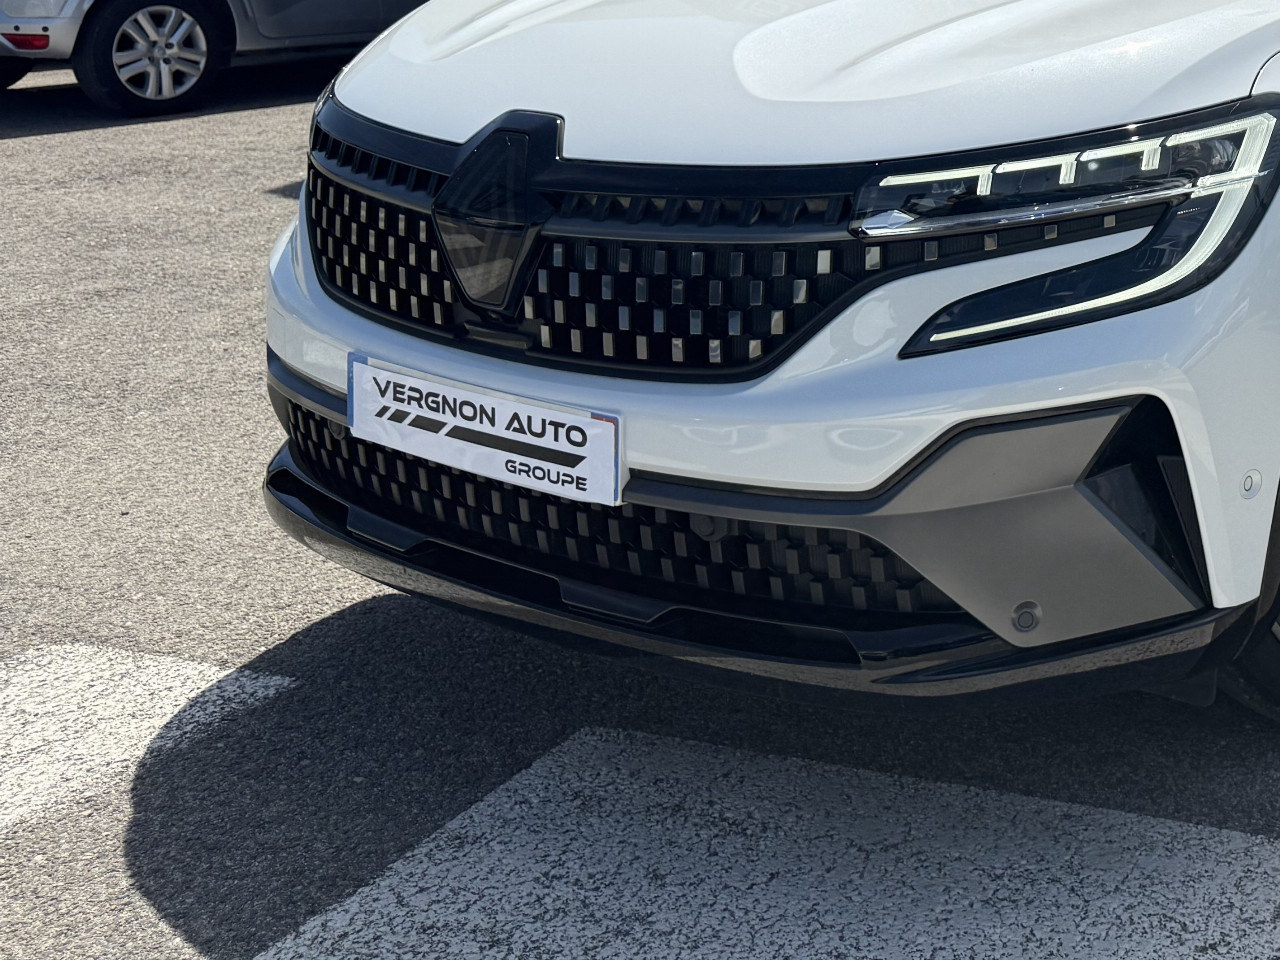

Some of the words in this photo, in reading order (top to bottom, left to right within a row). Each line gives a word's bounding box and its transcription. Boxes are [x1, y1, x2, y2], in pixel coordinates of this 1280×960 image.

[372, 376, 496, 427] VERGNON
[504, 411, 588, 448] AUTO
[504, 459, 588, 492] GROUPE
